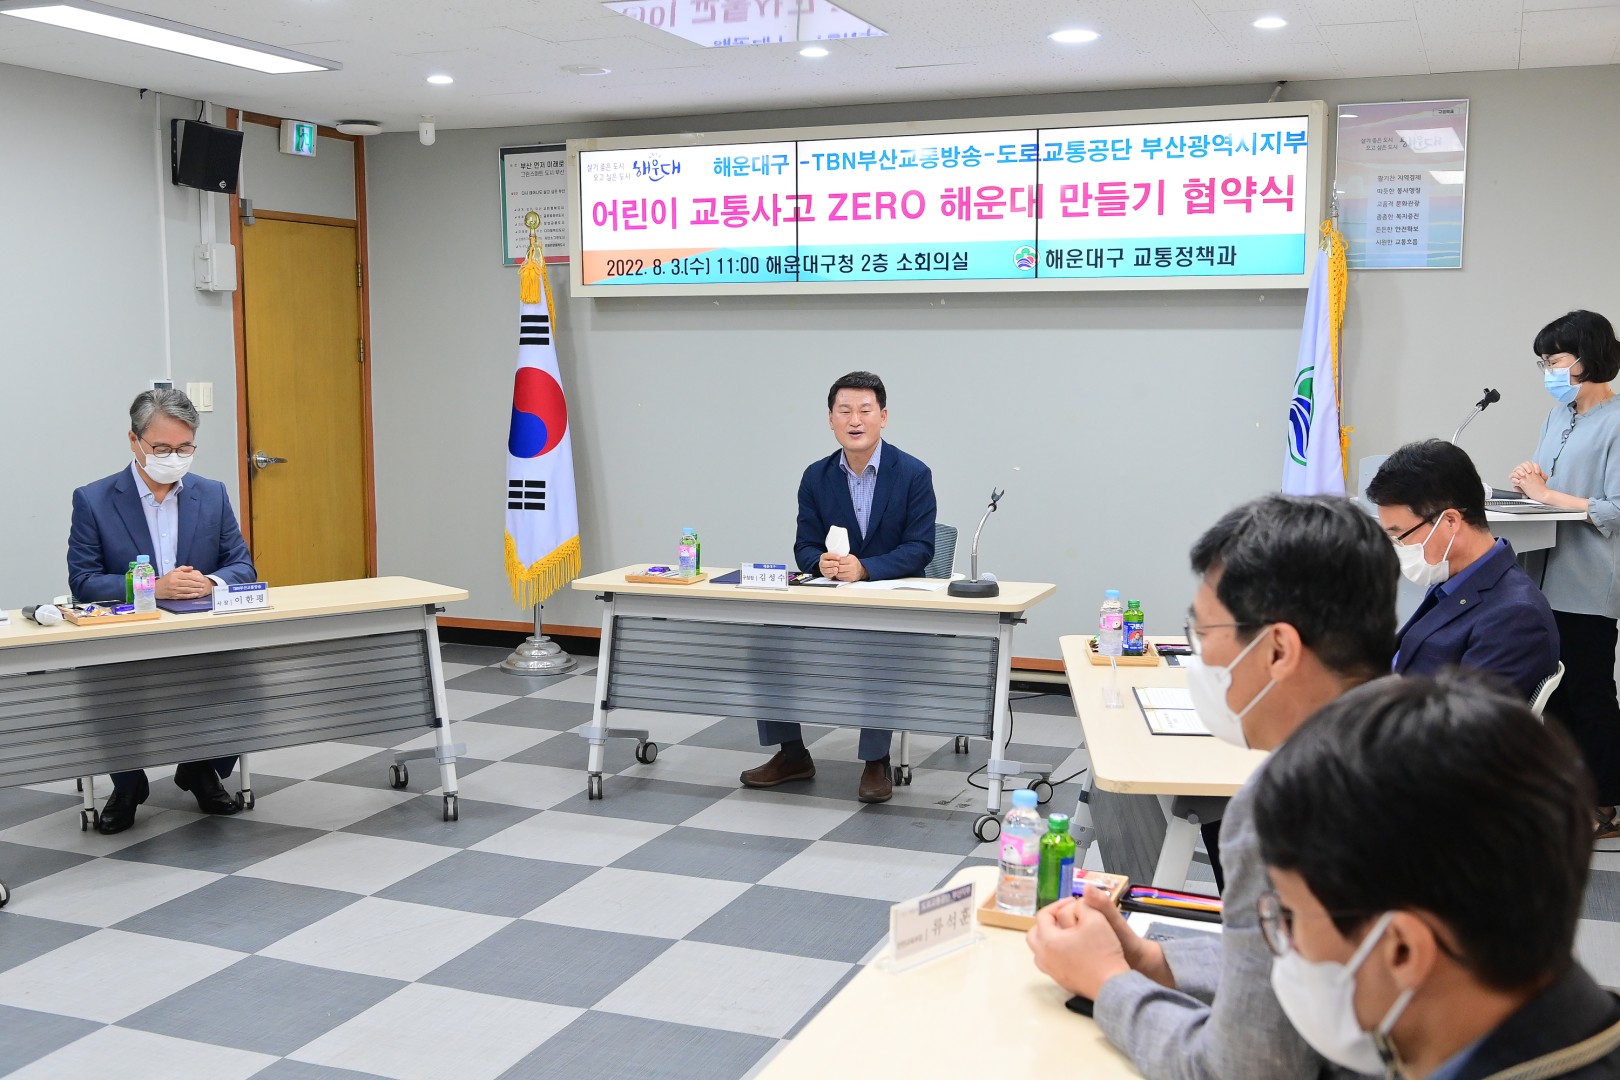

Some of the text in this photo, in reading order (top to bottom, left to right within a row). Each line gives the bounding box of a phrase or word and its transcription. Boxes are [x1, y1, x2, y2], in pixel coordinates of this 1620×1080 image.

[713, 154, 790, 178] 해운대구
[1141, 131, 1308, 160] 부산광역시지부
[587, 162, 625, 172] 살기 좋은 도시
[593, 172, 631, 182] 오고 싶은 도시
[632, 158, 681, 178] 해운대
[592, 175, 1294, 231] 어린이 교통사고 ZERO 해운대 만들기 협약식
[606, 252, 968, 276] 2022. 8. 3.(수) 11:00 해운대구청 2층 소회의실
[1046, 246, 1237, 270] 해운대구 교통정책과
